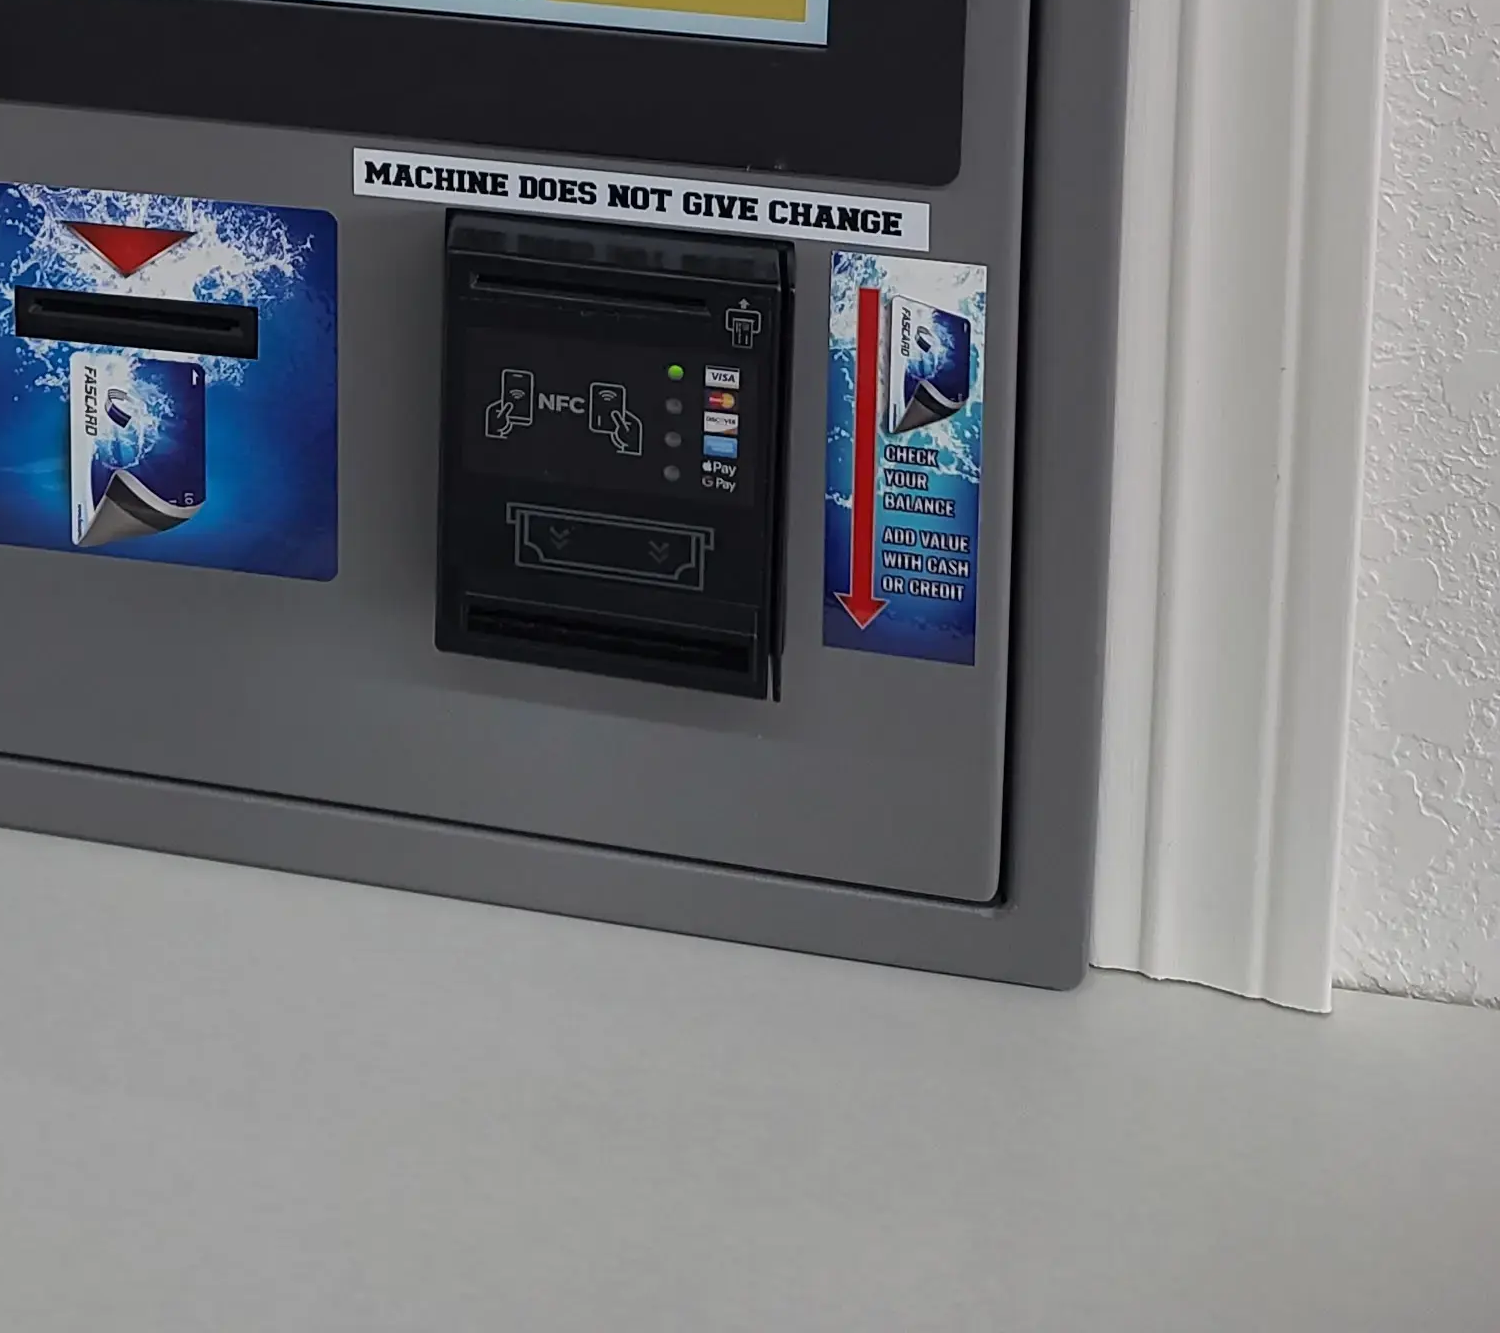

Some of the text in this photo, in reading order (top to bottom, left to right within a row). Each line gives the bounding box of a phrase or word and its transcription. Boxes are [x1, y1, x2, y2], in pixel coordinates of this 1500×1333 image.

[364, 161, 903, 237] MACHINE DOES NOT GIVE CHANGE
[902, 307, 911, 357] FASCARD
[712, 372, 735, 383] VISA
[84, 366, 97, 436] FASCARD
[538, 393, 585, 414] NFC
[886, 446, 937, 465] CHECK
[713, 461, 736, 477] Pay
[885, 470, 927, 489] YOUR
[716, 477, 736, 492] Pay
[885, 494, 954, 516] BALANCE
[884, 528, 968, 551] ADD VALUE
[884, 552, 968, 576] WITH CASH
[883, 577, 964, 601] OR CREDIT
